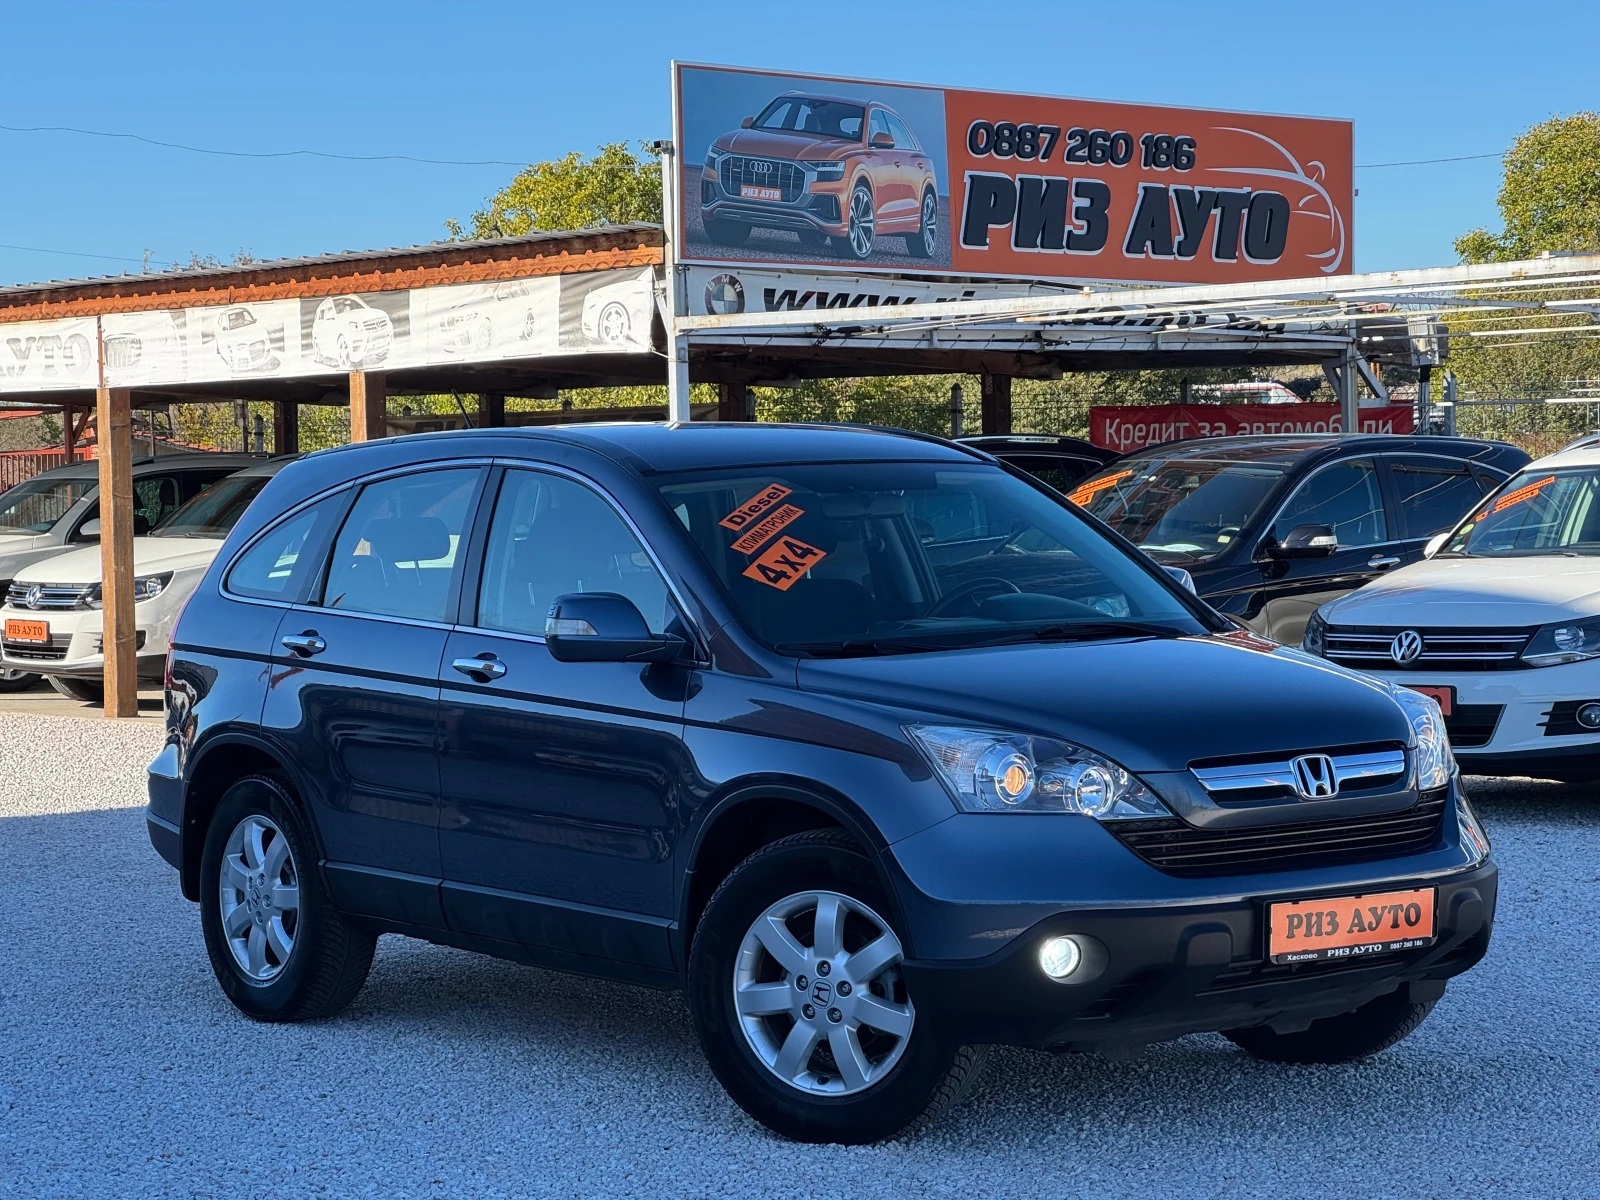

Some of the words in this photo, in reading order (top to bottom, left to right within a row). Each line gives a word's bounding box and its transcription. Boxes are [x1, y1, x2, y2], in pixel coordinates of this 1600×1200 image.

[967, 119, 1061, 162] 0887
[1064, 127, 1134, 166] 260
[1139, 133, 1197, 171] 186
[742, 187, 758, 196] РИЗ
[760, 190, 779, 198] АУТО
[960, 170, 1111, 255] РИЗ
[1122, 182, 1290, 265] АУТО
[707, 274, 743, 292] BMW
[0, 333, 91, 377] УТО
[1105, 418, 1190, 451] Кредит
[1198, 422, 1228, 436] за
[726, 486, 787, 526] Diesel
[736, 506, 800, 552] КЛИМАТРОНИК
[22, 626, 42, 635] АУТО
[1286, 911, 1339, 939] РИЗ
[1347, 902, 1421, 934] АУТО
[1287, 953, 1318, 961] Хасково
[1327, 949, 1350, 958] РИЗ
[1352, 944, 1382, 955] АУТО
